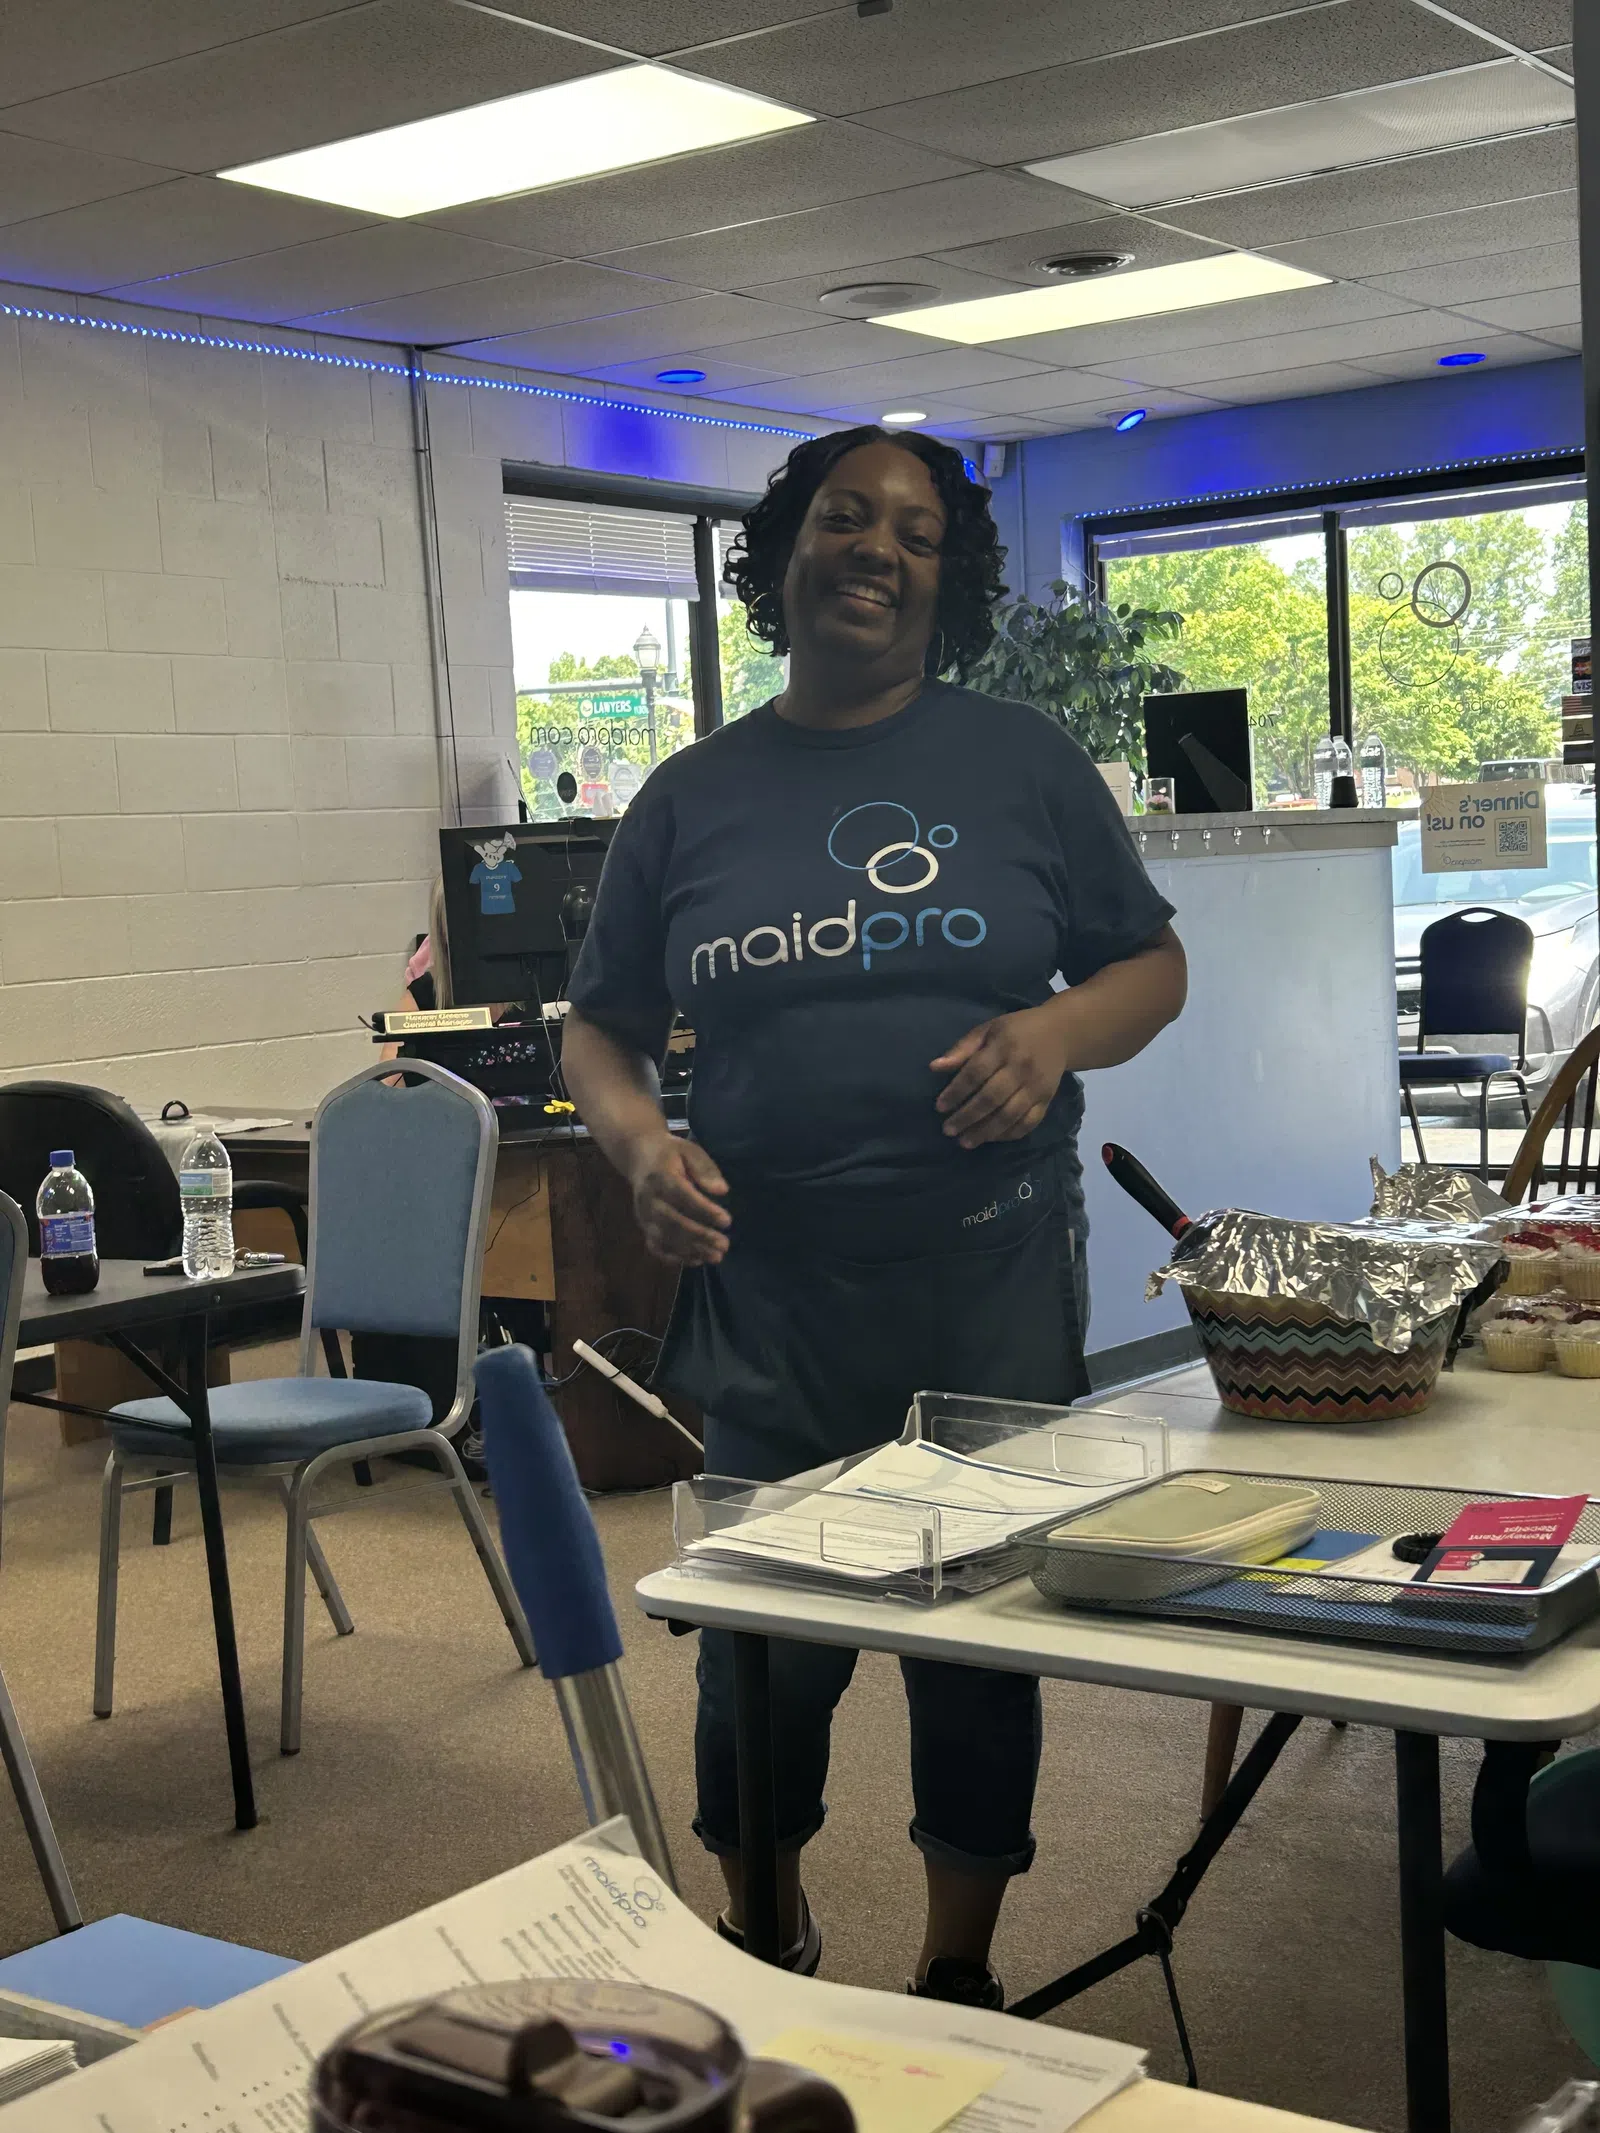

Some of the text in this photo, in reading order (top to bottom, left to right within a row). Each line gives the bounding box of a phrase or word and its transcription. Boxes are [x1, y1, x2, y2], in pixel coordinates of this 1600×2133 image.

[1575, 682, 1592, 691] VIS
[594, 700, 632, 714] LAWYERS
[493, 883, 501, 892] 9
[691, 899, 987, 985] maidpro
[583, 1856, 647, 1928] maidpro
